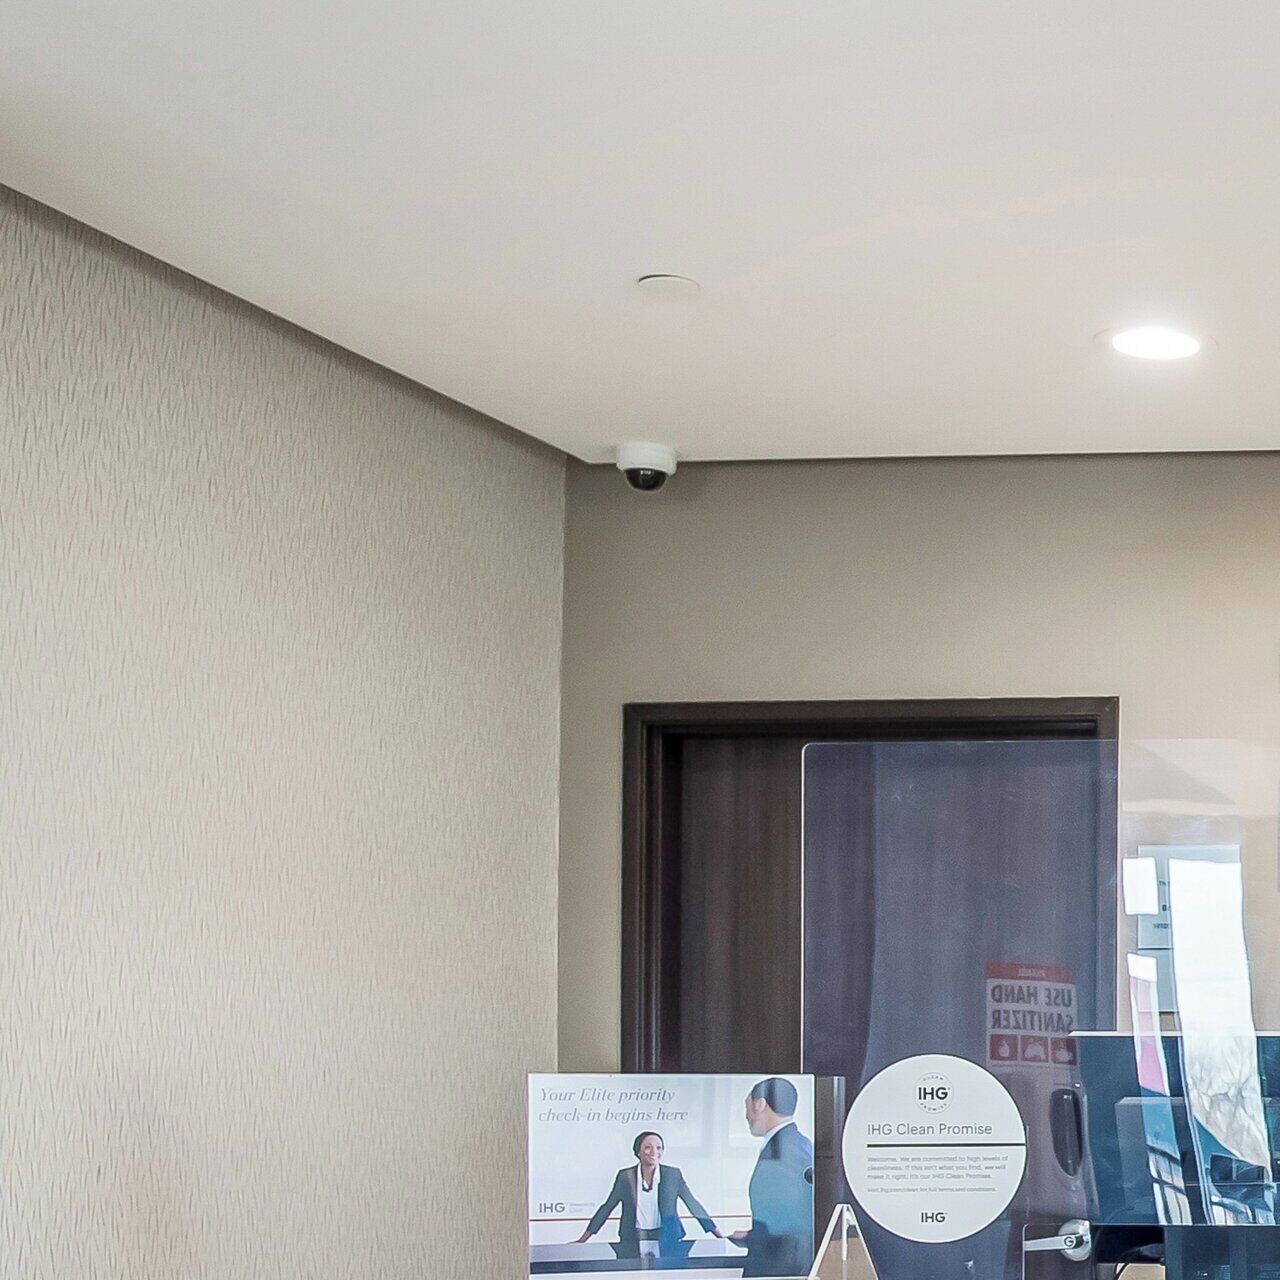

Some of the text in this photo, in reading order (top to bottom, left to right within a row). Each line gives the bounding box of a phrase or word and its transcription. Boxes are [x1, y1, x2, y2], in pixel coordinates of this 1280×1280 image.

[541, 1087, 676, 1104] Your Elite priority
[918, 1086, 948, 1100] IHG
[538, 1107, 689, 1125] check-in begins here
[867, 1122, 993, 1136] IHG Clean Promise
[539, 1202, 566, 1214] IHG
[921, 1212, 946, 1223] IHG
